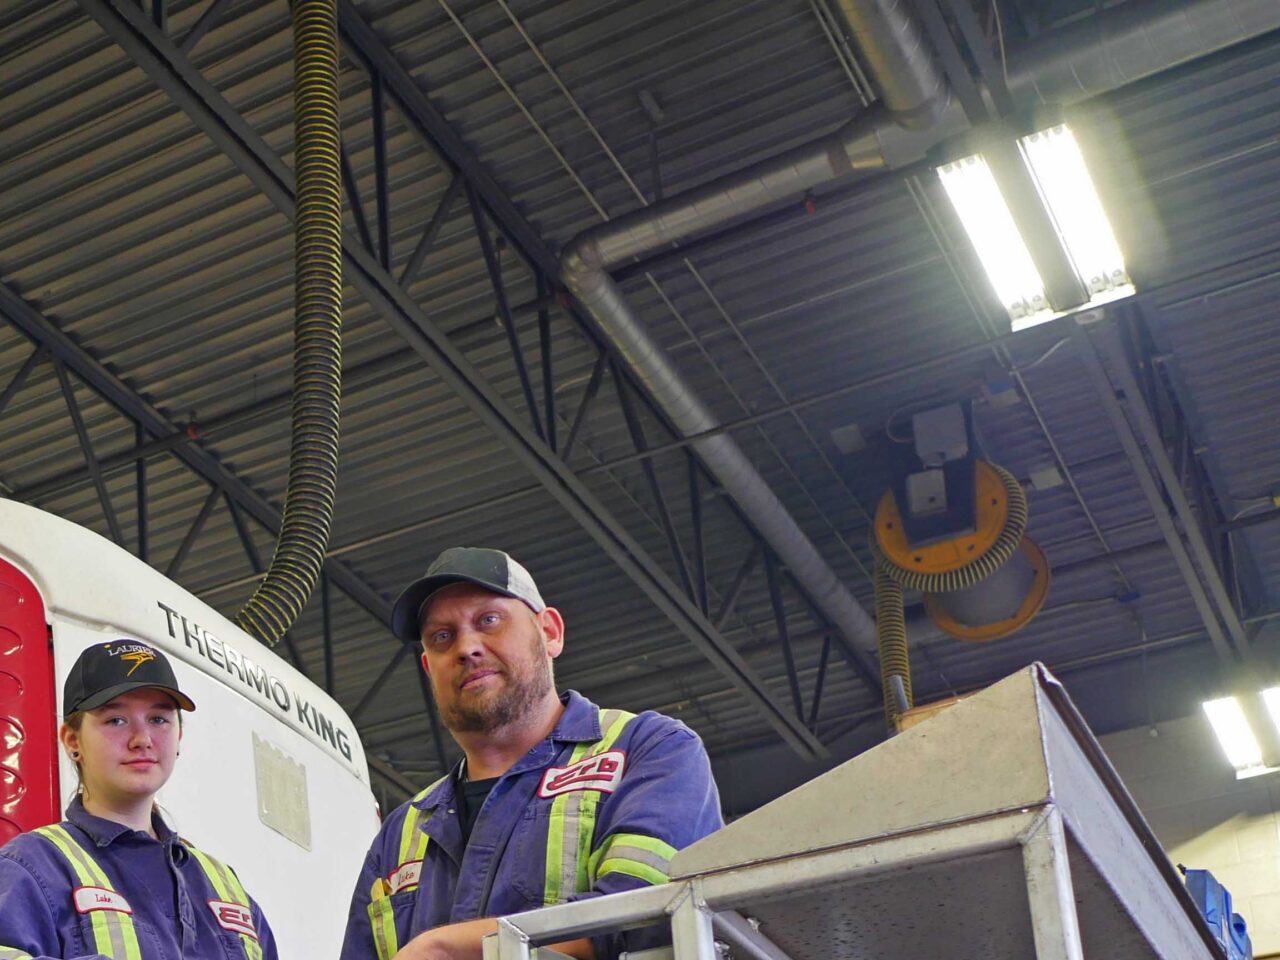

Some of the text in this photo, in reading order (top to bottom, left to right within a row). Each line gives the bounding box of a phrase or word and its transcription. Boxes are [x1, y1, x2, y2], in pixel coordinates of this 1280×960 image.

[108, 644, 157, 657] LAURIER
[157, 601, 352, 764] THERMO KING
[546, 758, 618, 790] Erb
[220, 907, 255, 930] Er
